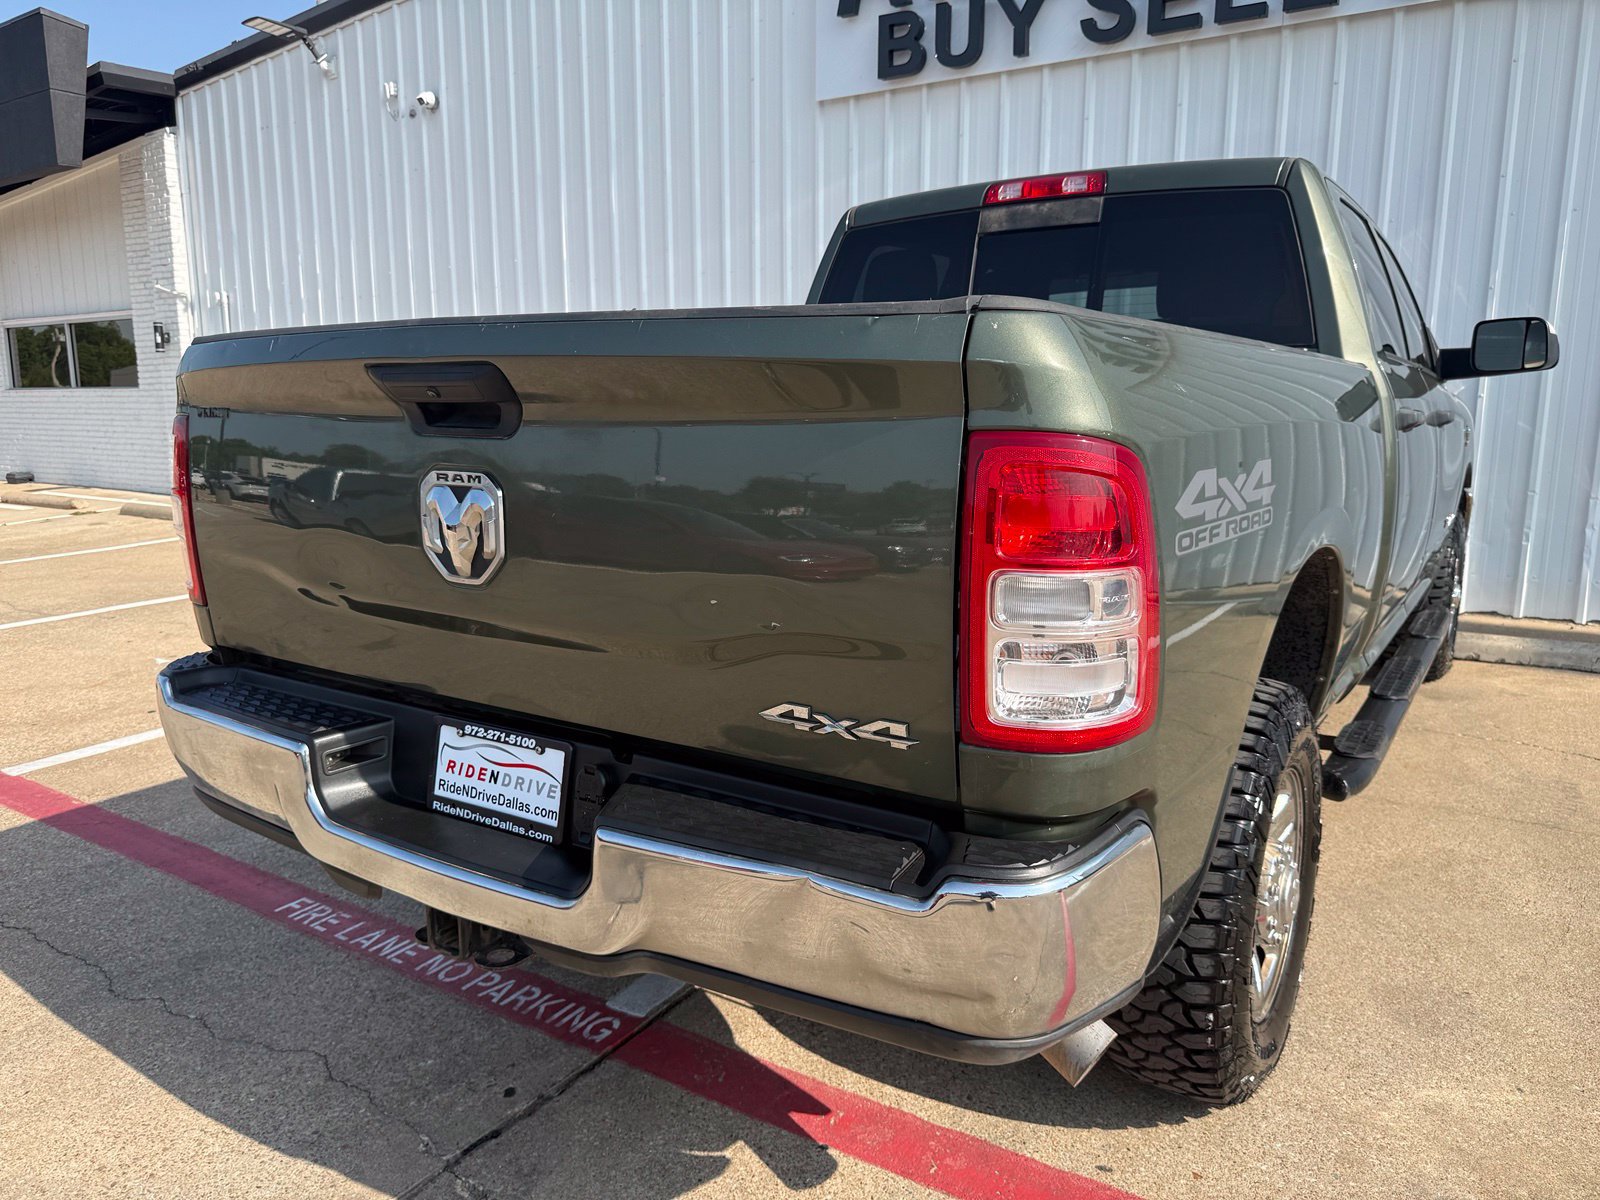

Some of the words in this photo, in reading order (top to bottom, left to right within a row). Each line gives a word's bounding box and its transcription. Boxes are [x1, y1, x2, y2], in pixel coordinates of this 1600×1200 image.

[877, 0, 1044, 80] BUY
[435, 472, 482, 485] RAM
[1177, 522, 1222, 553] OFF
[1225, 507, 1272, 538] ROAD
[464, 724, 536, 749] 972-271-5100
[438, 778, 558, 821] RideNDriveDallas.com
[432, 800, 553, 843] RideNDriveDallas.com
[274, 897, 352, 932] FIRE
[334, 921, 430, 964] LANE
[415, 954, 474, 982] NO
[461, 970, 621, 1043] PARKING
